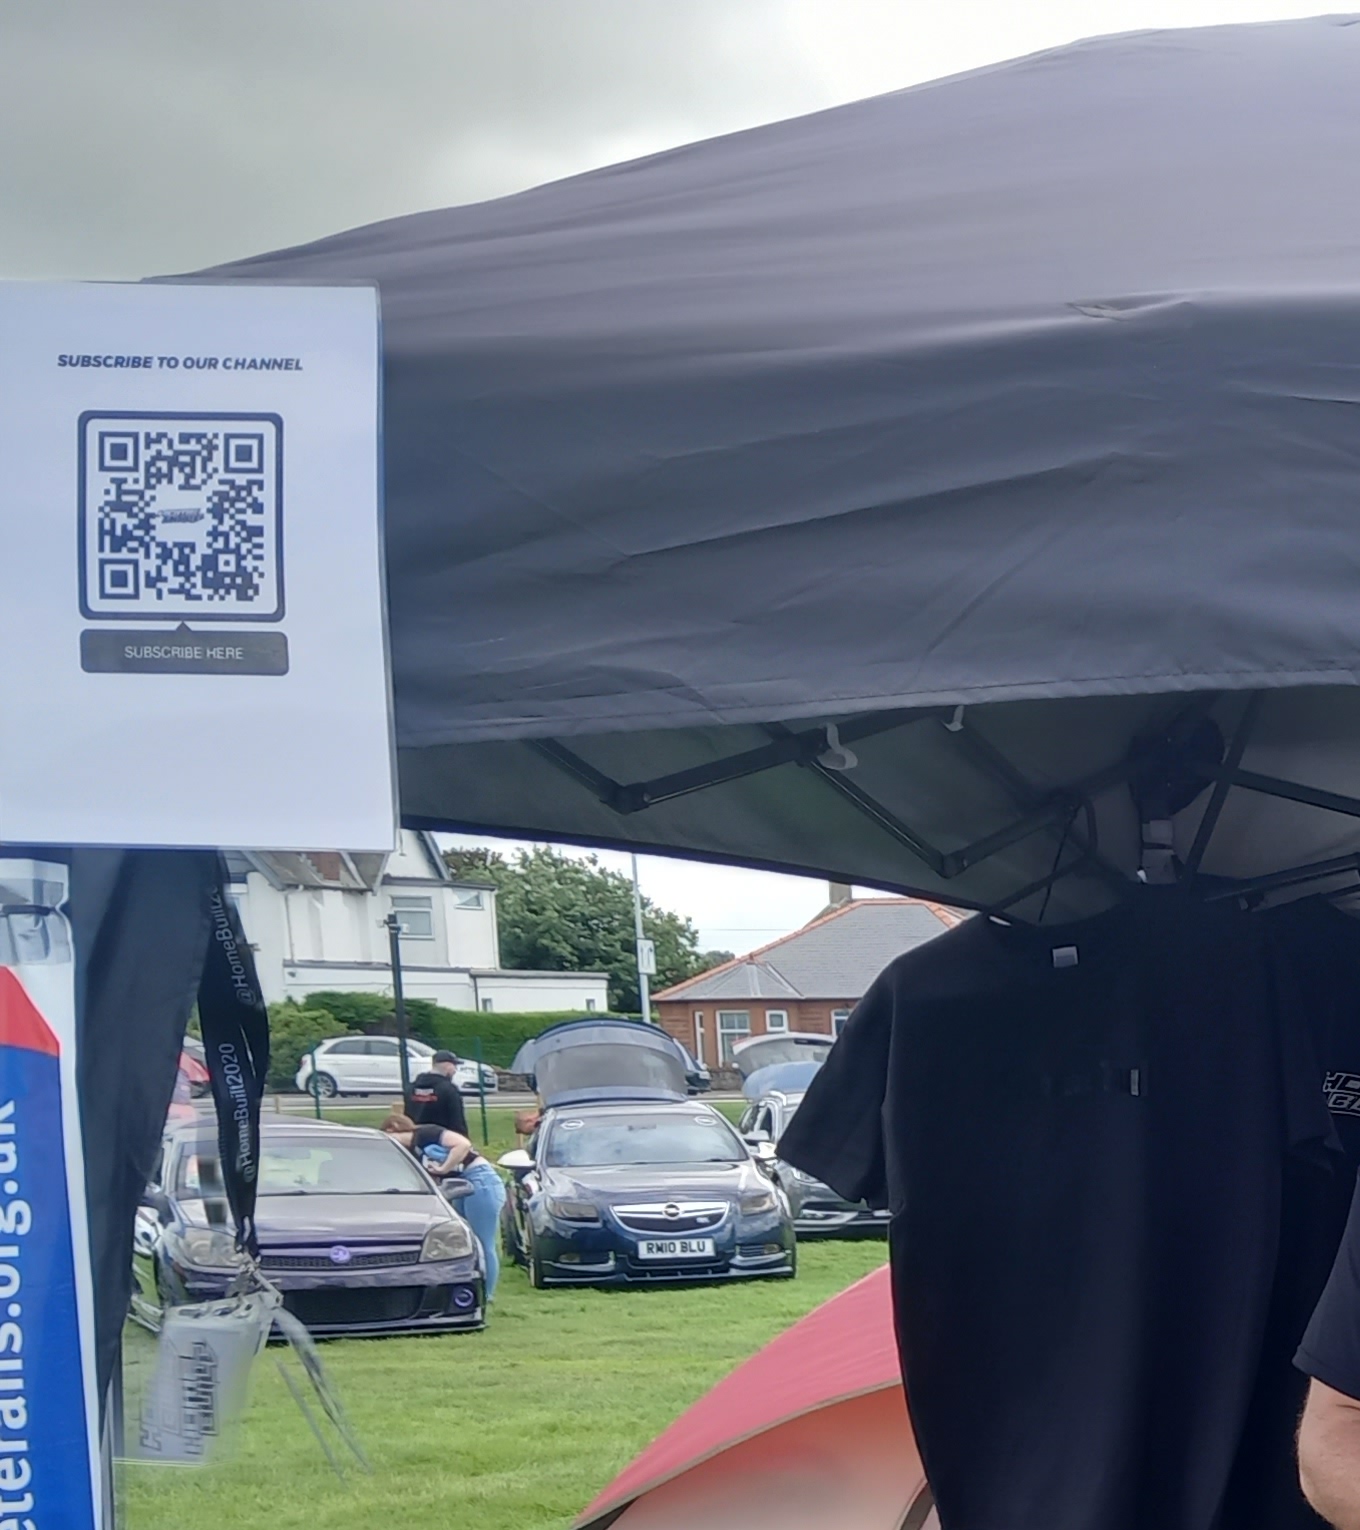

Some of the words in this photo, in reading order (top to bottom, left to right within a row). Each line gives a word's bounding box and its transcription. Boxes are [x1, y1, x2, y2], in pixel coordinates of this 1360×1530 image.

[58, 354, 153, 369] SUBSCRIBE
[158, 356, 179, 369] TO
[182, 357, 219, 370] OUR
[222, 357, 303, 371] CHANNEL
[124, 646, 202, 660] SUBSCRIBE
[206, 647, 244, 660] HERE
[217, 1042, 257, 1184] @HomeBuilt2020
[680, 1240, 706, 1254] BLU
